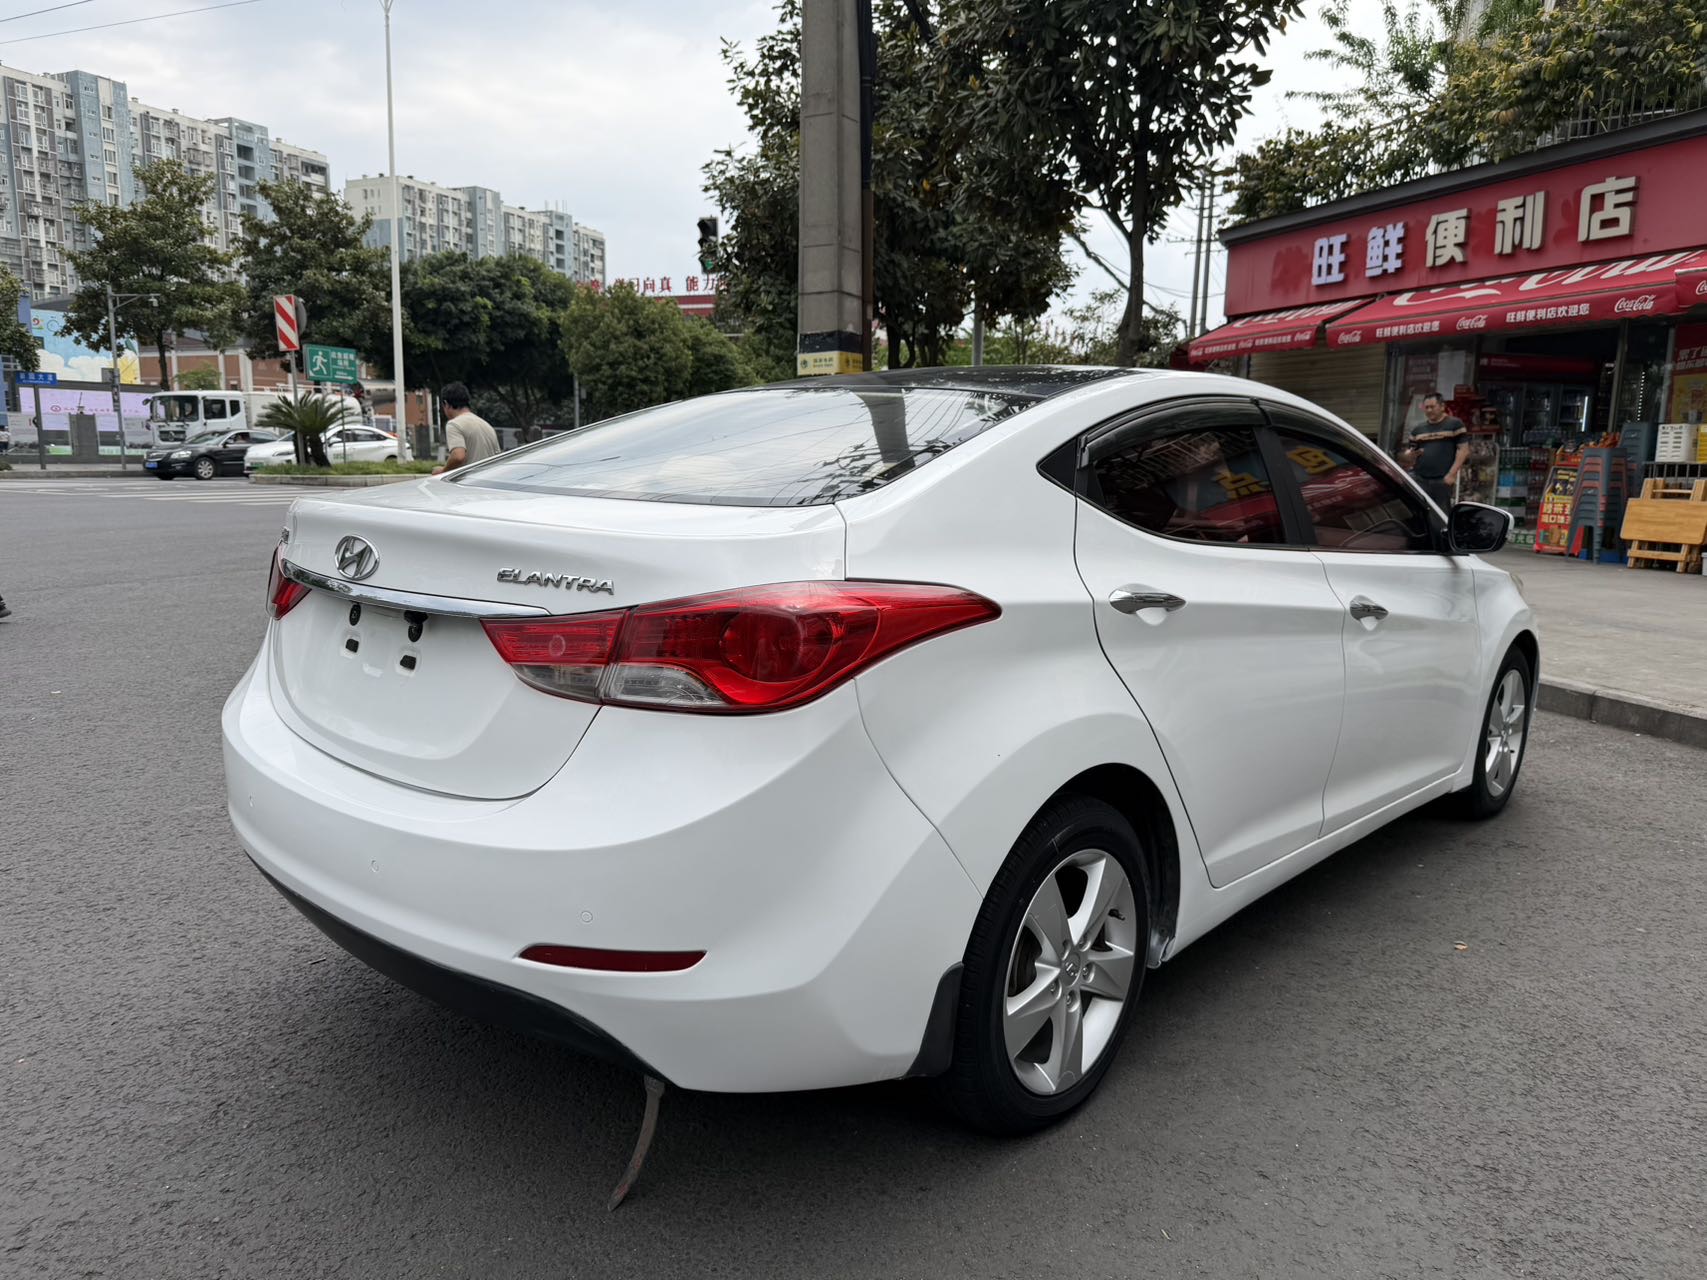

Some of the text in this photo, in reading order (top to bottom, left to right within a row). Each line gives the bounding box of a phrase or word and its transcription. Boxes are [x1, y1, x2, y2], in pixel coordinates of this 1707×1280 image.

[1311, 176, 1641, 286] 旺鲜便利店
[686, 274, 728, 292] 能力
[1506, 304, 1590, 322] 旺鲜便利店欢迎您
[496, 567, 614, 596] ELANTRA
